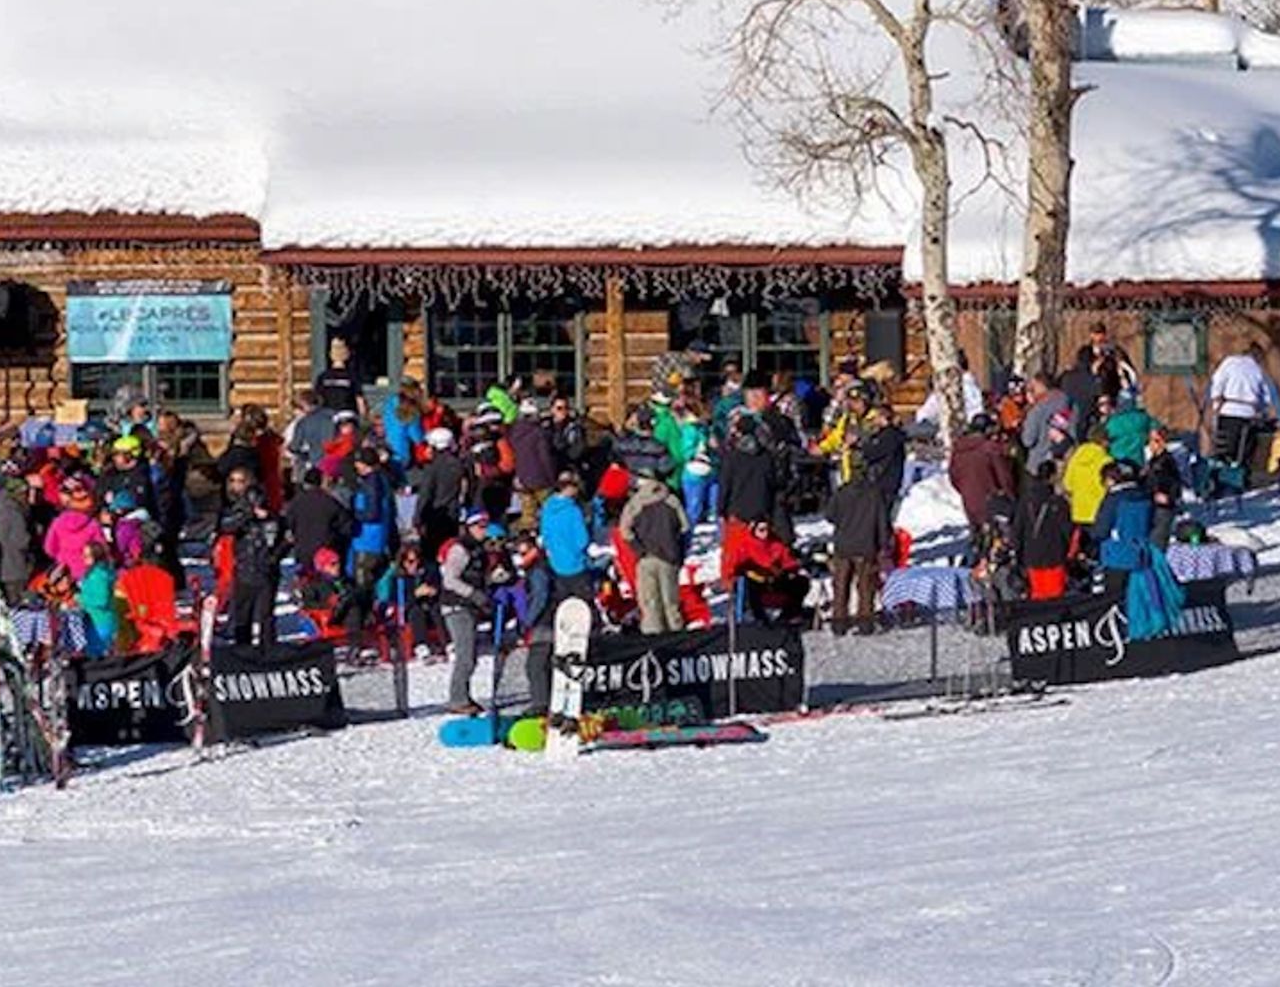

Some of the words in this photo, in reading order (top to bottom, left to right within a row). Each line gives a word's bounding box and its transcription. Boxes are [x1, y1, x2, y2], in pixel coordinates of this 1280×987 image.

[1019, 619, 1092, 656] ASPEN
[667, 648, 796, 687] SNOWMASS.
[76, 678, 162, 711] ASPEN
[213, 665, 332, 703] SNOWMASS.
